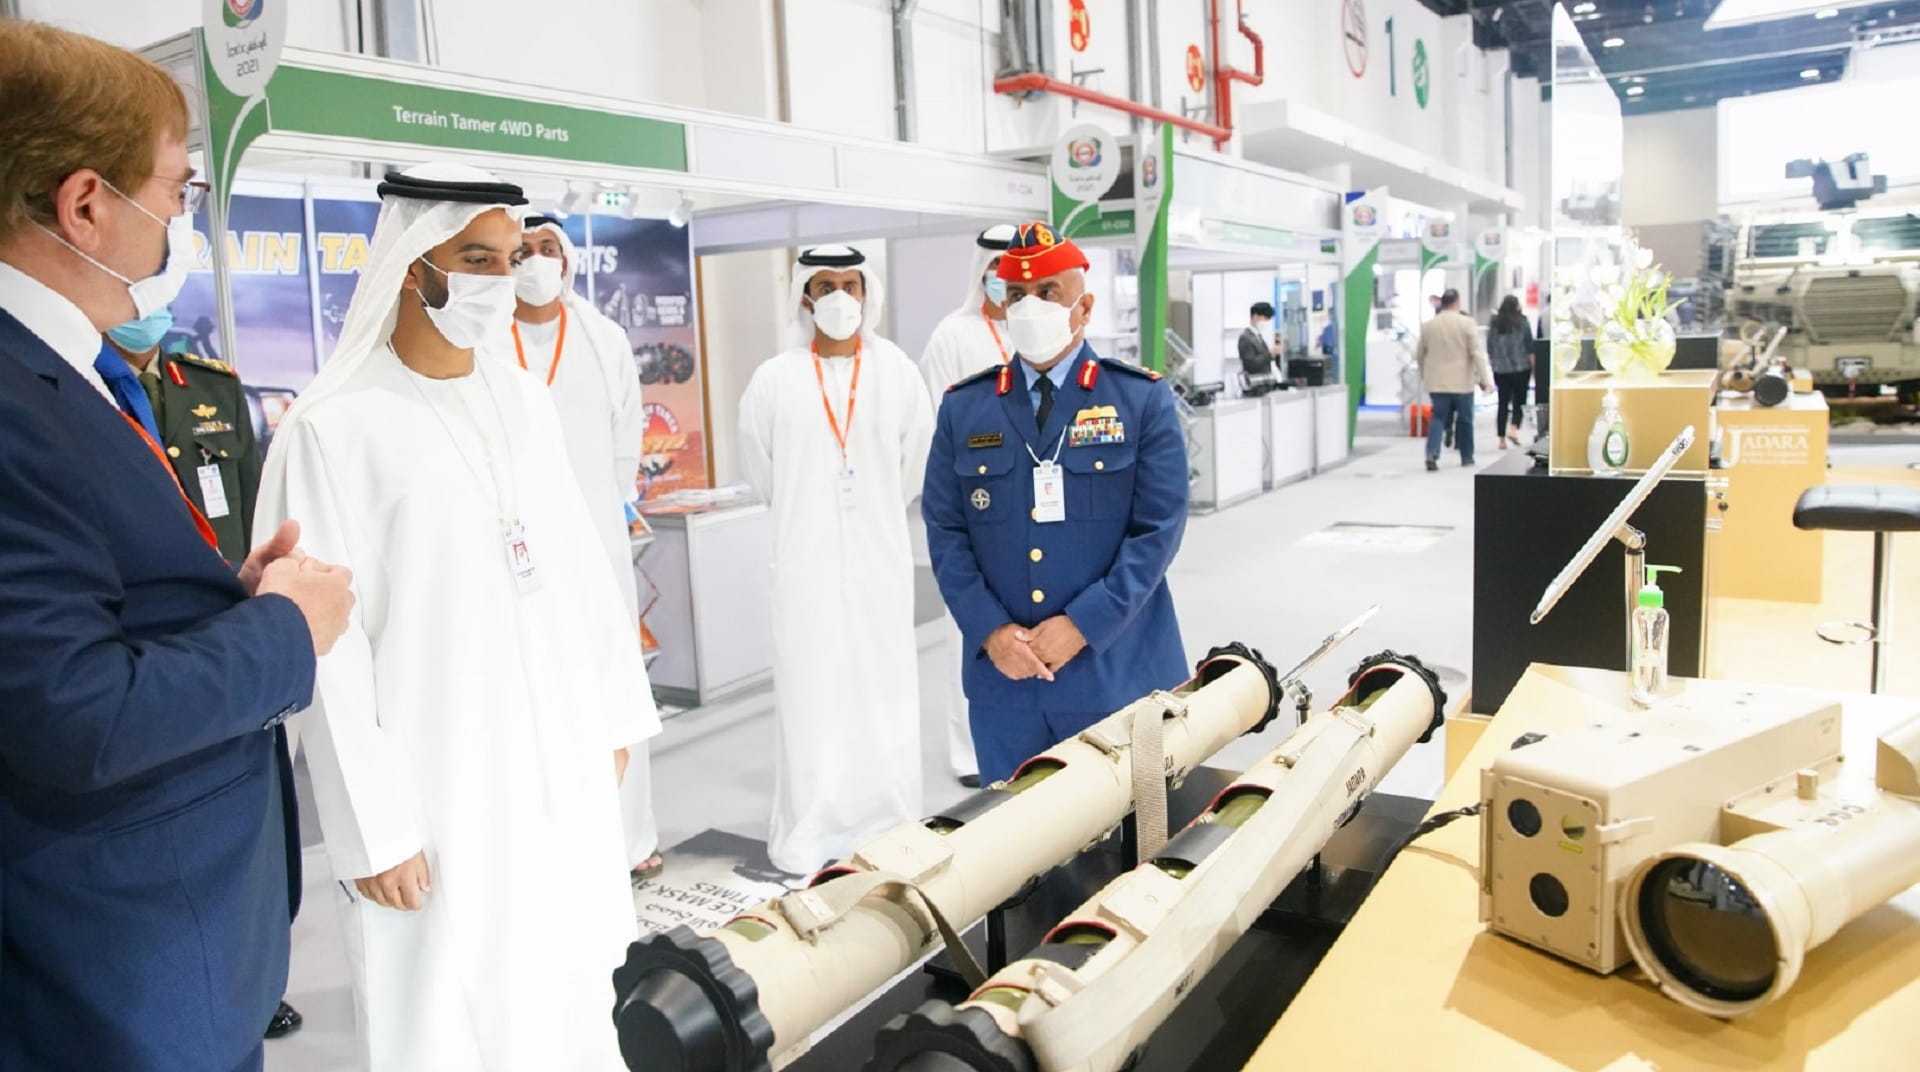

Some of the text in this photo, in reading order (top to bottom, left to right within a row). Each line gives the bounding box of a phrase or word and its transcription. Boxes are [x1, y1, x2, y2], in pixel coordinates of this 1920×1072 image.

[236, 58, 259, 77] 2021
[1384, 16, 1396, 96] 1
[392, 105, 570, 142] Terrain Tamer 4WD Parts
[1720, 427, 1809, 469] JADARA
[651, 885, 711, 908] MASK
[689, 882, 750, 905] TIMES
